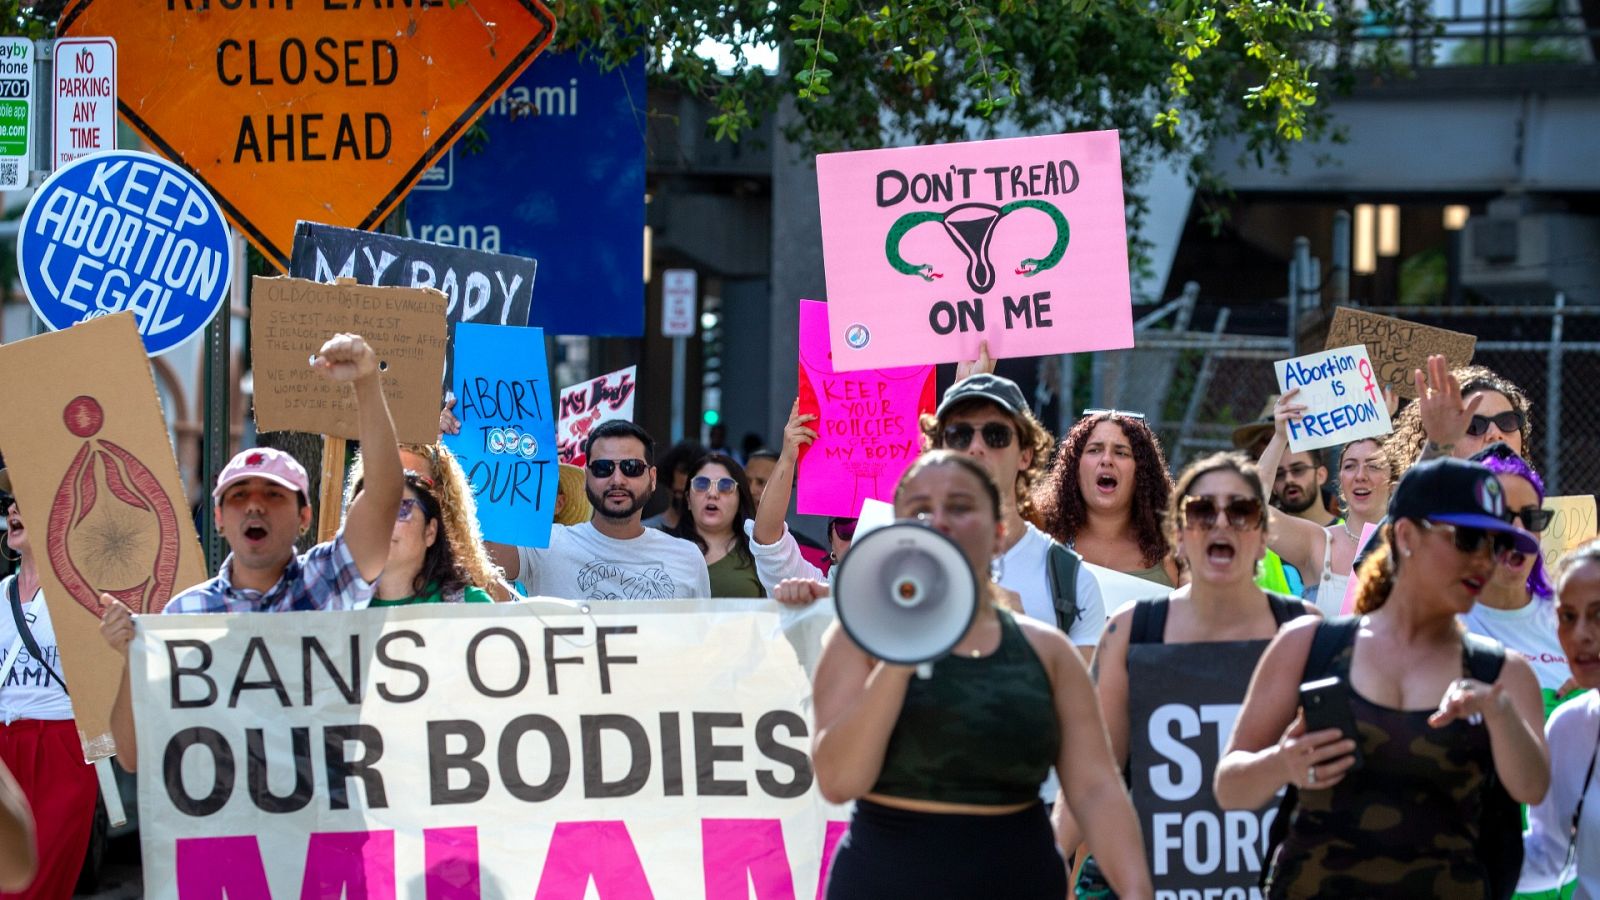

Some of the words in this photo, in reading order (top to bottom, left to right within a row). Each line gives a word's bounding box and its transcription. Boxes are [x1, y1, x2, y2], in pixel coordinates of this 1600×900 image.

[0, 42, 28, 59] ayby
[0, 59, 28, 74] hone
[76, 52, 94, 74] NO
[217, 37, 398, 86] CLOSED
[60, 77, 110, 97] PARKING
[489, 78, 577, 115] iami
[14, 106, 26, 120] app
[73, 102, 97, 122] ANY
[0, 124, 25, 136] e.com
[70, 128, 100, 148] TIME
[234, 113, 391, 163] AHEAD
[87, 160, 209, 232] KEEP
[876, 164, 976, 207] DON'T
[984, 159, 1079, 201] TREAD
[36, 186, 222, 302] ABORTION
[406, 219, 500, 253] rena
[315, 246, 399, 286] MY
[40, 242, 184, 336] LEGAL
[929, 298, 984, 335] ON
[1003, 291, 1053, 330] ME
[1348, 316, 1420, 342] ABORT
[1358, 335, 1408, 362] THE
[1286, 354, 1356, 389] Abortion
[1332, 380, 1345, 397] is
[462, 377, 542, 422] ABORT
[560, 389, 587, 420] My
[587, 375, 634, 411] Body
[823, 380, 887, 403] KEEP
[841, 400, 894, 417] YOUR
[1288, 399, 1379, 440] FREEDOM
[826, 446, 853, 460] MY
[865, 440, 912, 459] BODY
[456, 456, 550, 511] OURT
[1545, 506, 1593, 540] ODY
[165, 630, 429, 710] BANS
[466, 625, 638, 698] OFF
[162, 723, 389, 817] OUR
[427, 710, 815, 806] BODIES
